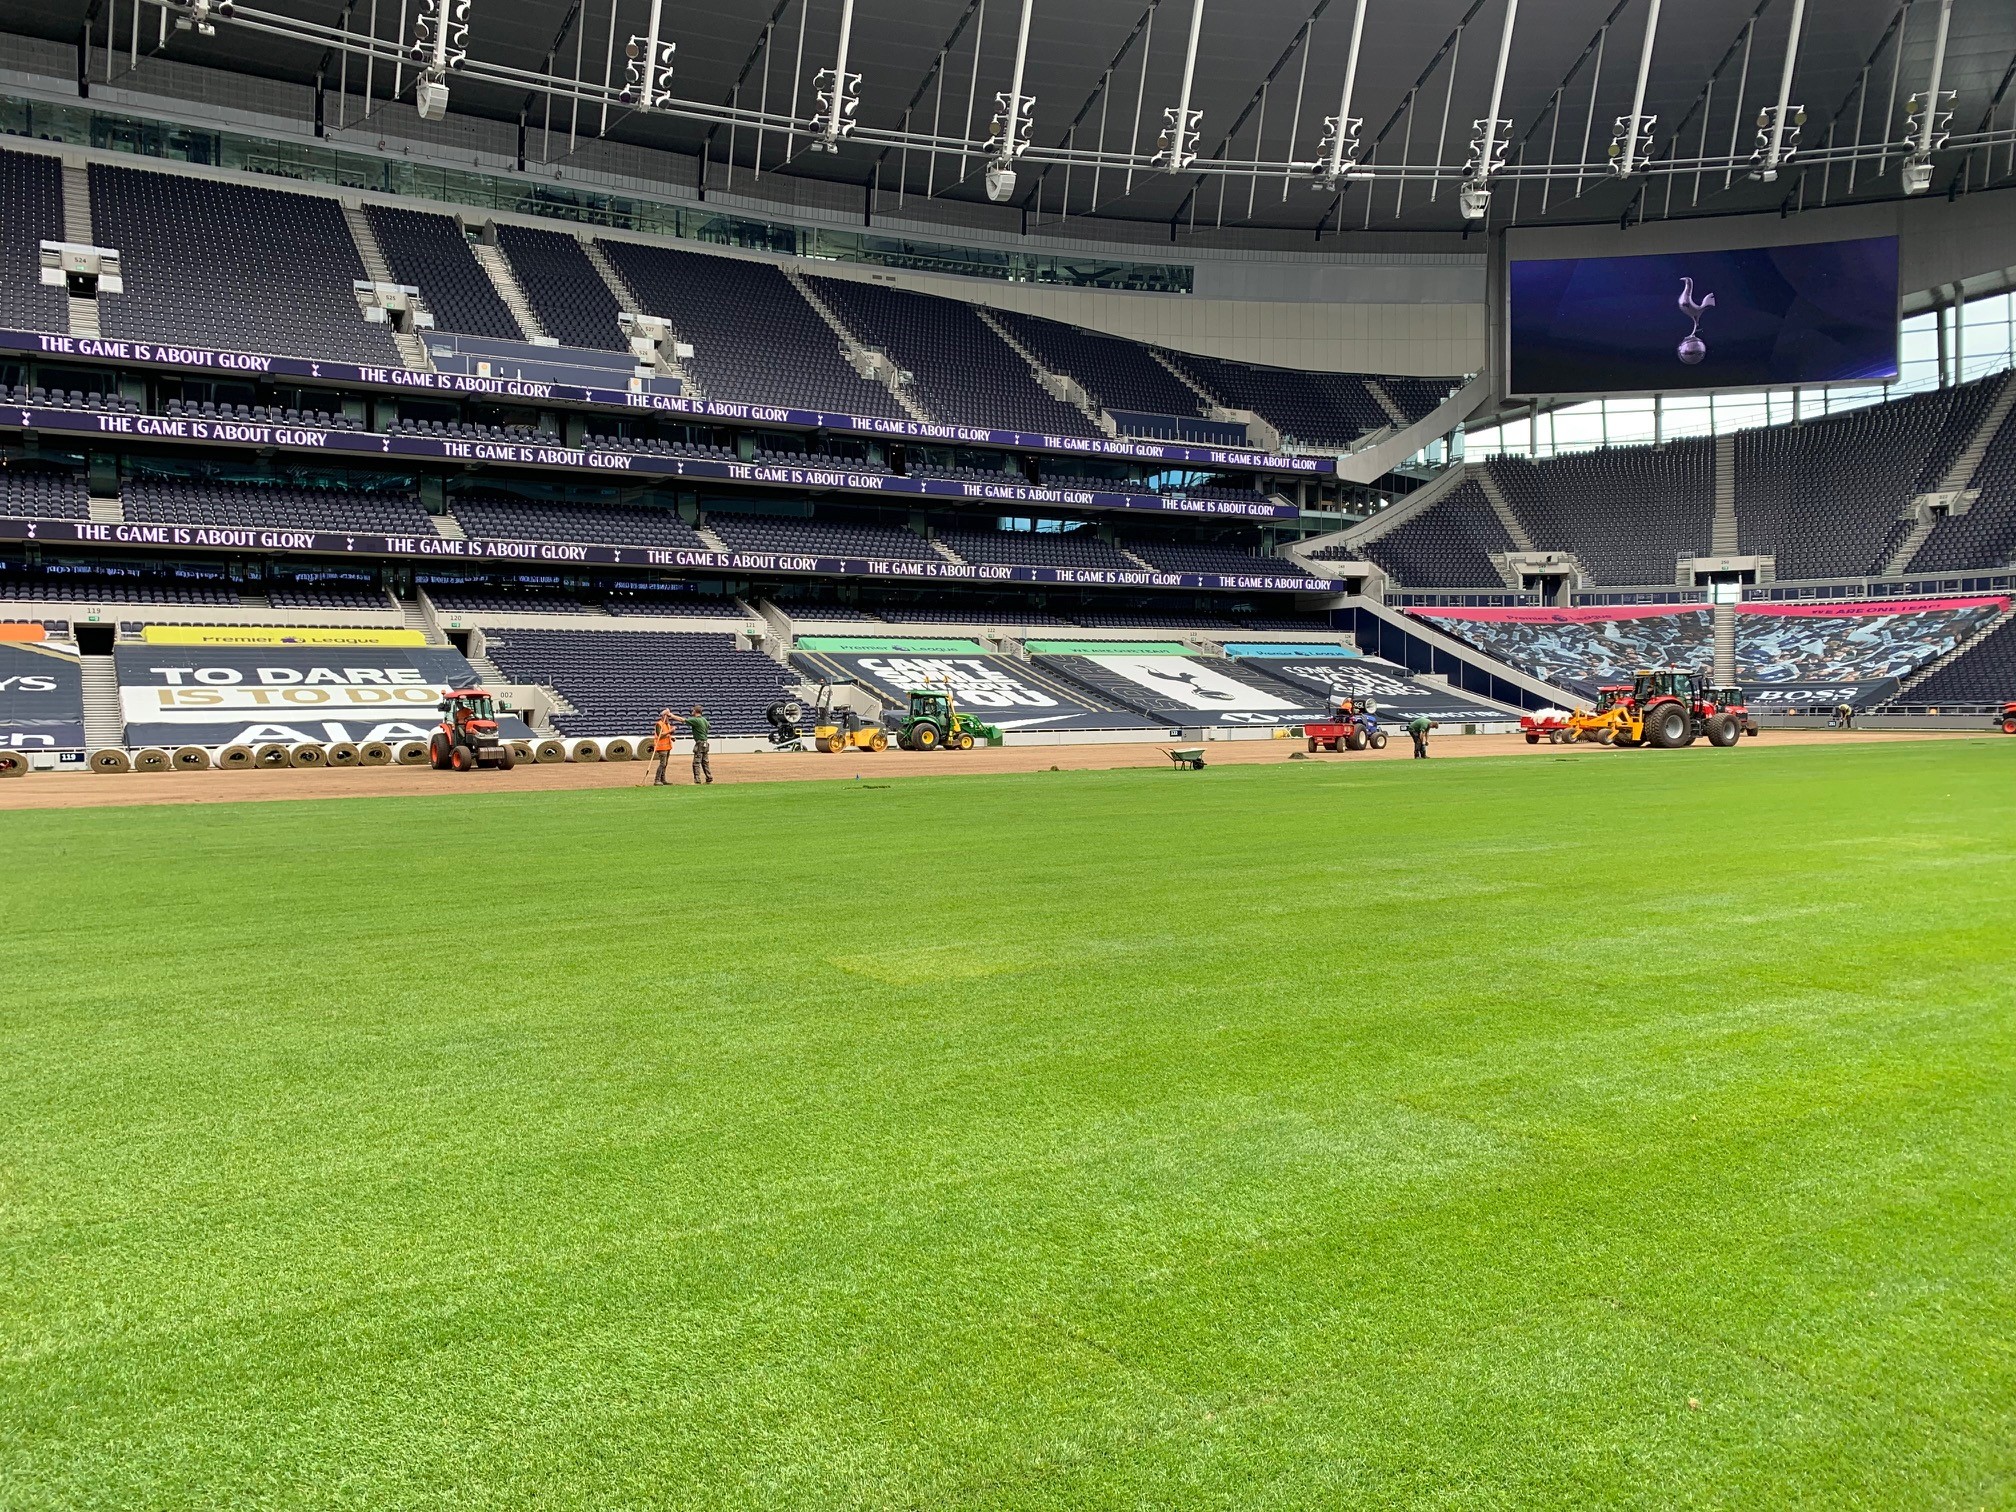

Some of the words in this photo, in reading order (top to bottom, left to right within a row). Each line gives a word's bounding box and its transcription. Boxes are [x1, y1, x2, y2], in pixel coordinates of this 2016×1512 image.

[74, 256, 87, 264] 524
[39, 335, 74, 352] THE
[78, 339, 130, 358] GAME
[134, 344, 151, 360] IS
[155, 346, 214, 365] ABOUT
[218, 352, 271, 371] GLORY
[358, 367, 388, 382] THE
[391, 370, 434, 387] GAME
[438, 374, 451, 388] IS
[454, 376, 504, 393] ABOUT
[507, 381, 552, 398] GLORY
[625, 393, 650, 407] THE
[653, 395, 689, 411] GAME
[692, 400, 703, 413] IS
[706, 401, 748, 417] ABOUT
[751, 406, 789, 421] GLORY
[97, 415, 132, 432] THE
[136, 418, 187, 436] GAME
[192, 422, 208, 437] IS
[212, 424, 271, 442] ABOUT
[275, 428, 327, 446] GLORY
[850, 417, 872, 430] THE
[874, 419, 905, 433] GAME
[907, 422, 917, 434] IS
[920, 423, 955, 438] ABOUT
[957, 427, 990, 441] GLORY
[444, 442, 471, 457] THE
[475, 444, 516, 460] GAME
[520, 447, 533, 461] IS
[537, 449, 585, 465] ABOUT
[588, 453, 631, 469] GLORY
[1043, 436, 1062, 448] THE
[1063, 437, 1090, 450] GAME
[1092, 440, 1101, 451] IS
[1102, 441, 1134, 454] ABOUT
[1135, 444, 1164, 457] GLORY
[1210, 451, 1226, 462] THE
[1228, 452, 1251, 464] GAME
[1253, 455, 1261, 465] IS
[1262, 455, 1290, 468] ABOUT
[1291, 458, 1317, 470] GLORY
[729, 465, 751, 478] THE
[754, 467, 789, 481] GAME
[792, 470, 802, 482] IS
[805, 471, 845, 486] ABOUT
[848, 474, 883, 489] GLORY
[962, 484, 983, 496] THE
[984, 485, 1014, 498] GAME
[1016, 487, 1026, 499] IS
[1028, 488, 1061, 501] ABOUT
[1063, 491, 1094, 504] GLORY
[1162, 498, 1178, 509] THE
[1180, 499, 1205, 511] GAME
[1207, 501, 1215, 512] IS
[1217, 502, 1246, 514] ABOUT
[1248, 504, 1274, 515] GLORY
[73, 523, 111, 540] THE
[116, 525, 169, 542] GAME
[174, 528, 190, 543] IS
[195, 528, 256, 545] ABOUT
[260, 531, 315, 548] GLORY
[384, 537, 416, 552] THE
[419, 539, 464, 554] GAME
[468, 541, 482, 555] IS
[486, 542, 537, 557] ABOUT
[541, 544, 587, 560] GLORY
[646, 550, 673, 563] THE
[676, 551, 714, 565] GAME
[717, 553, 729, 566] IS
[732, 554, 776, 568] ABOUT
[778, 556, 818, 570] GLORY
[867, 561, 889, 573] THE
[892, 562, 924, 575] GAME
[926, 563, 937, 575] IS
[939, 564, 976, 577] ABOUT
[978, 565, 1012, 578] GLORY
[1055, 569, 1074, 581] THE
[1076, 570, 1104, 582] GAME
[1106, 571, 1115, 582] IS
[1117, 571, 1150, 584] ABOUT
[1152, 573, 1182, 585] GLORY
[1219, 576, 1236, 587] THE
[1238, 576, 1263, 587] GAME
[1264, 577, 1273, 588] IS
[1274, 578, 1303, 589] ABOUT
[1305, 578, 1331, 590] GLORY
[312, 637, 380, 645] League
[857, 658, 990, 672] CAN'T
[150, 667, 243, 684] TO
[256, 667, 427, 684] DARE
[875, 670, 1018, 683] SMILE
[157, 688, 224, 705] IS
[236, 688, 331, 705] TO
[346, 687, 439, 703] DO
[1754, 687, 1859, 700] BOSS
[230, 720, 433, 744] AIA
[61, 753, 76, 761] 119
